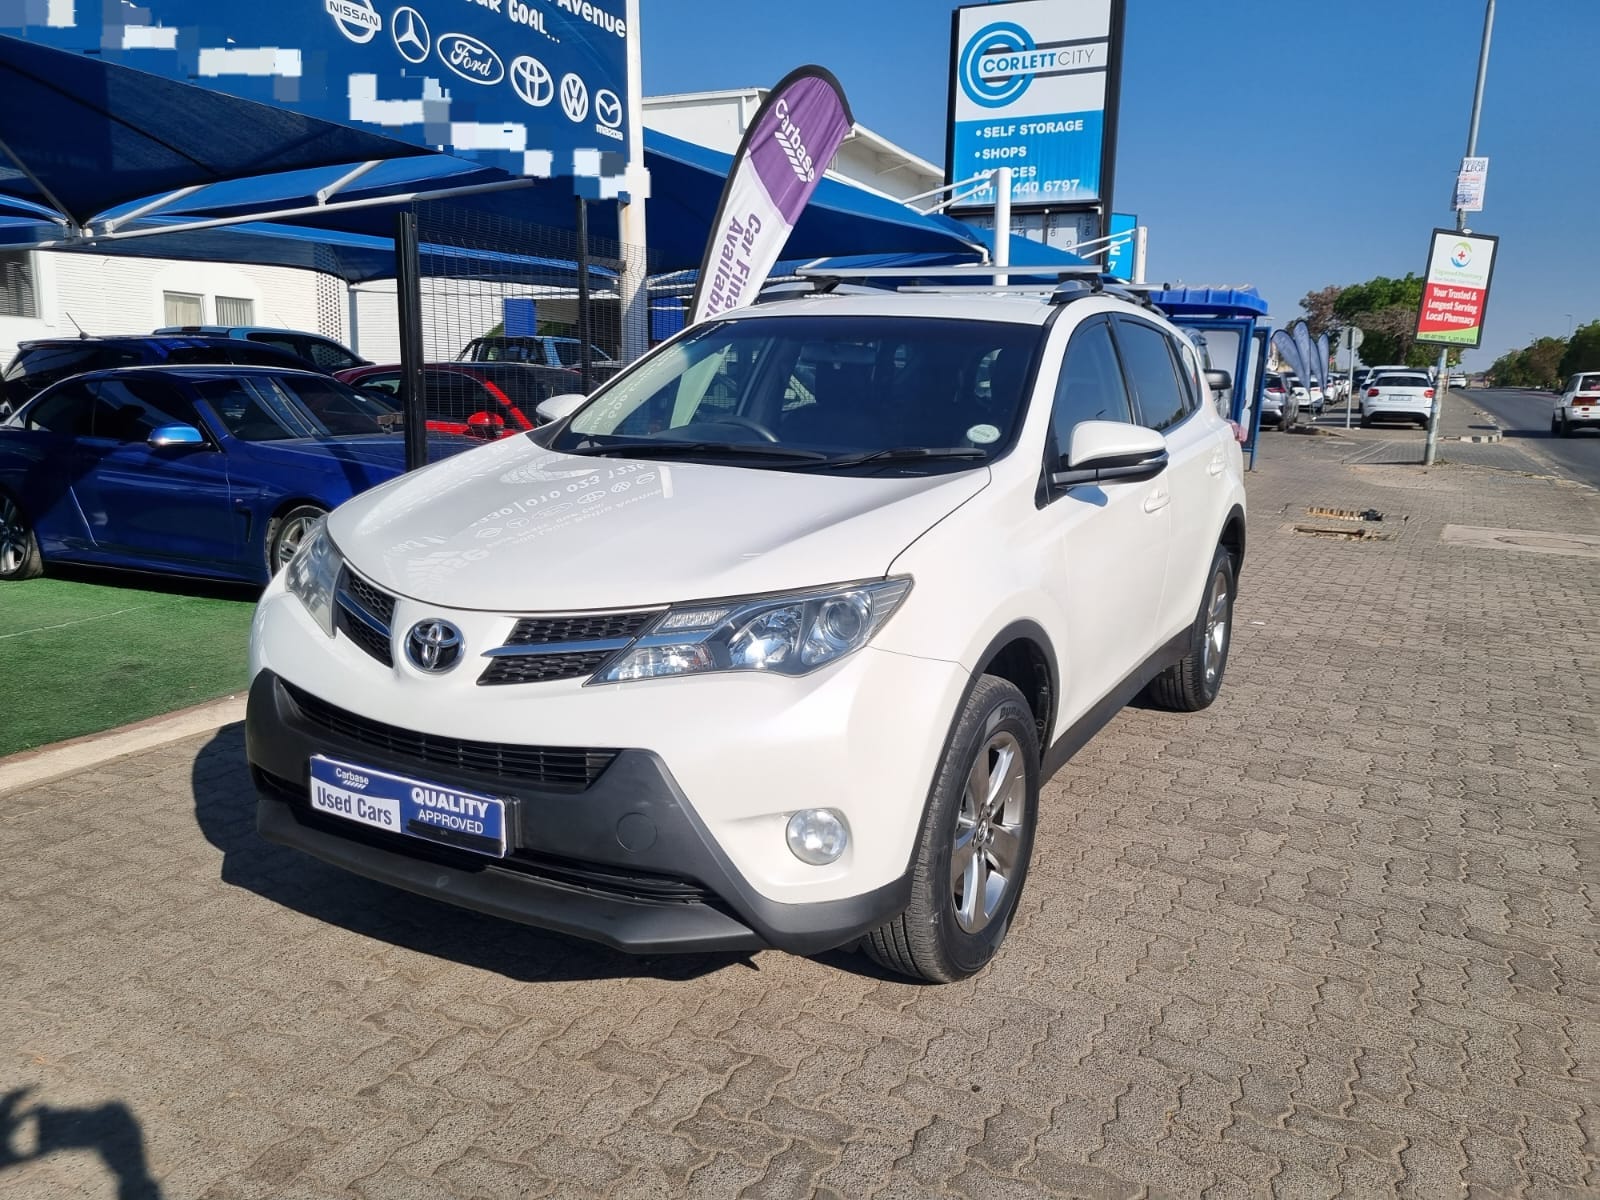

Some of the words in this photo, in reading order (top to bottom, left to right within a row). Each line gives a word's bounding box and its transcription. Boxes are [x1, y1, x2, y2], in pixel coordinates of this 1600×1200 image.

[329, 0, 378, 27] NISSAN
[450, 40, 493, 77] Ford
[775, 99, 815, 183] Carbase
[983, 125, 1016, 138] SELF
[1019, 119, 1084, 135] STORAGE
[982, 145, 1027, 160] SHOPS
[981, 166, 1037, 179] OCES
[1012, 181, 1039, 193] 440
[1043, 178, 1080, 192] 6797
[741, 213, 761, 257] Car
[705, 216, 744, 317] Availabl
[725, 258, 750, 309] Fina
[1426, 311, 1444, 321] Local
[335, 767, 369, 785] Carbase
[317, 786, 352, 814] Used
[357, 799, 393, 825] Cars
[411, 787, 489, 819] QUALITY
[418, 809, 484, 834] APPROVED
